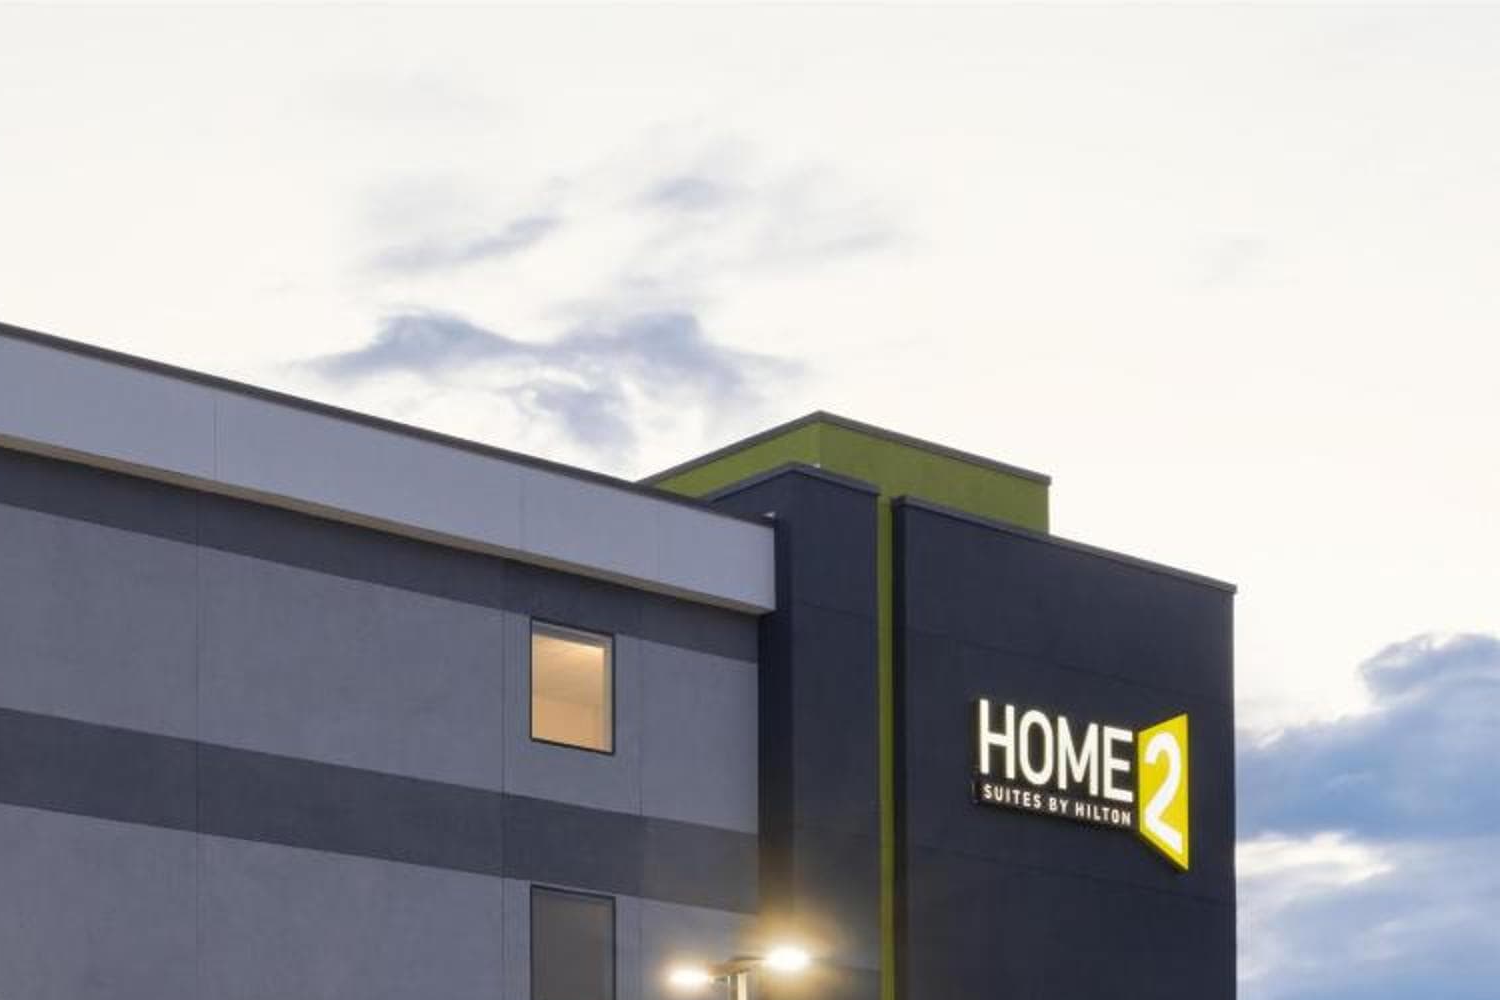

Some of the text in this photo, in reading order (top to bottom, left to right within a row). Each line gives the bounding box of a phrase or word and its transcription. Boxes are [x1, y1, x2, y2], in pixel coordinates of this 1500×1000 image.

[979, 698, 1183, 856] HOME 2
[983, 783, 1132, 827] SUITES BY HILTON
